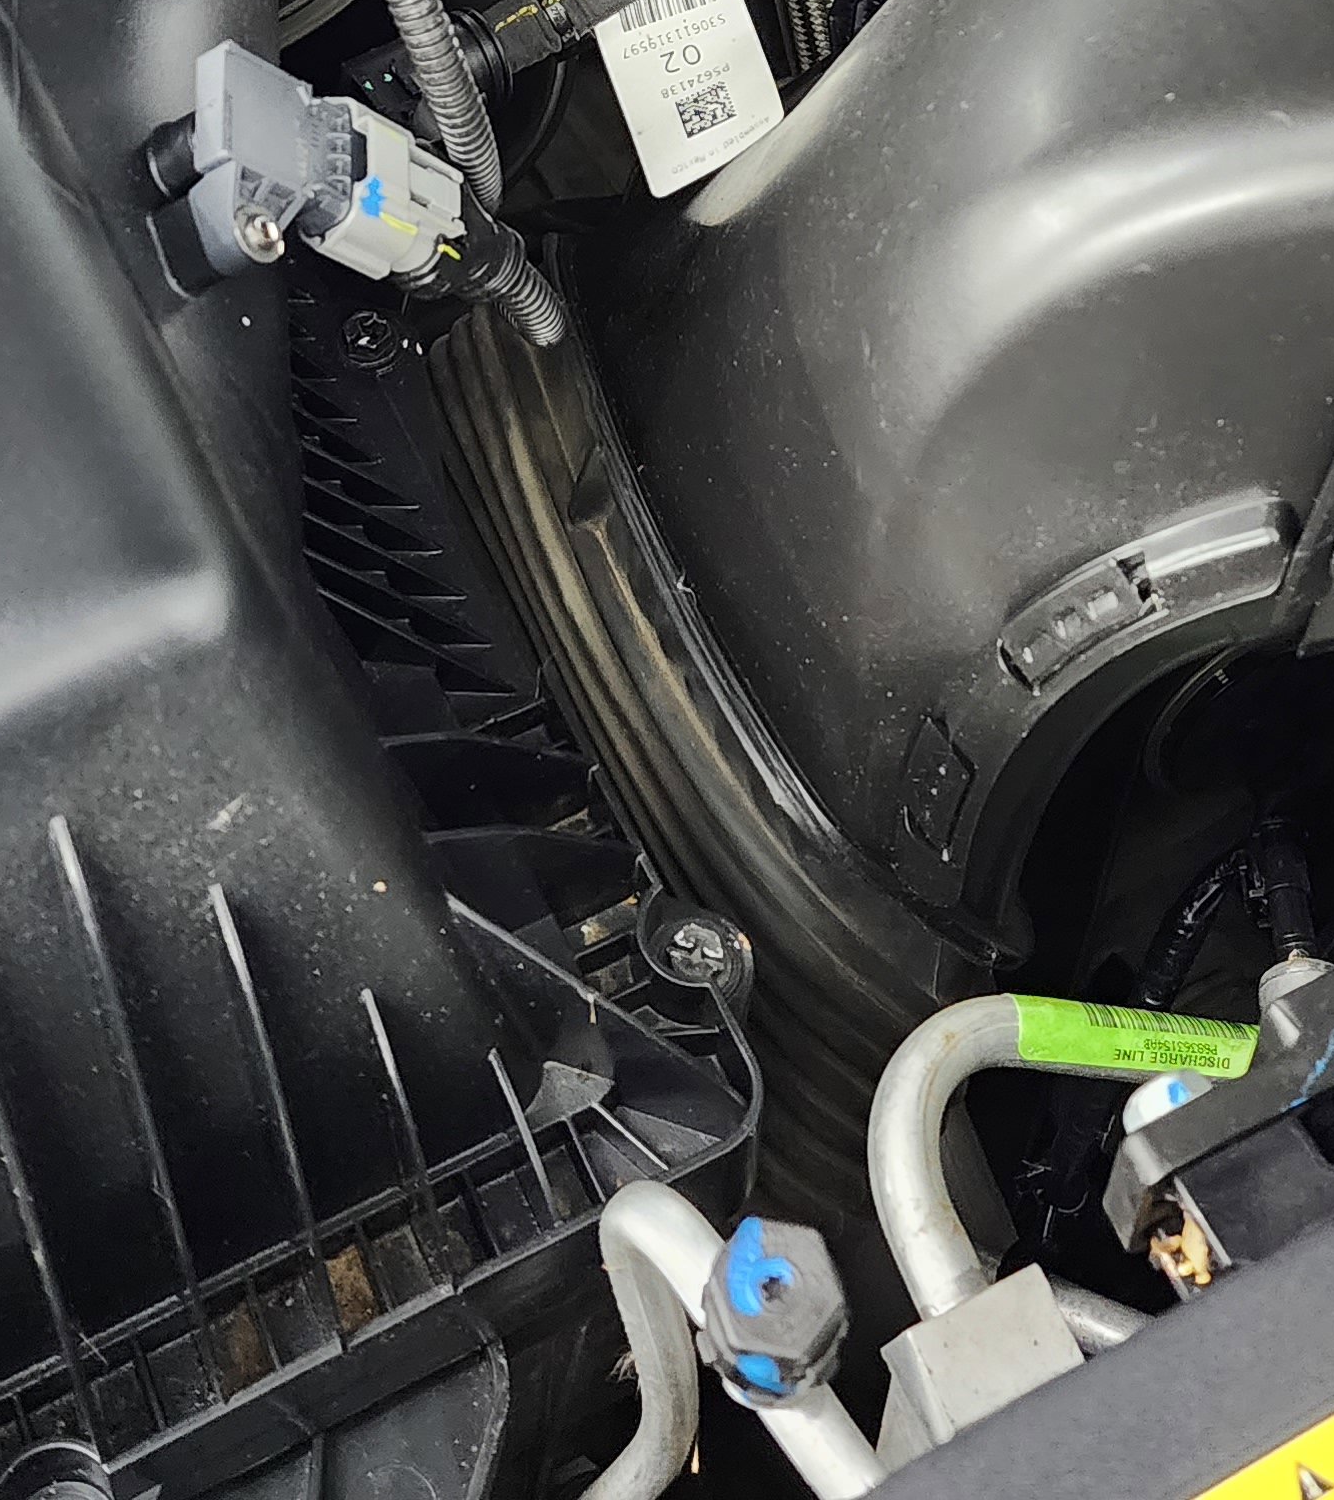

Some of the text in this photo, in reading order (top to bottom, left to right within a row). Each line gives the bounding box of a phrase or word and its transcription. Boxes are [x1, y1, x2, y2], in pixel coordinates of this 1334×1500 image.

[623, 13, 727, 60] S30611319597
[660, 44, 702, 74] 02
[722, 116, 771, 150] Assembled
[1113, 1048, 1231, 1070] DISCHARGE LINE
